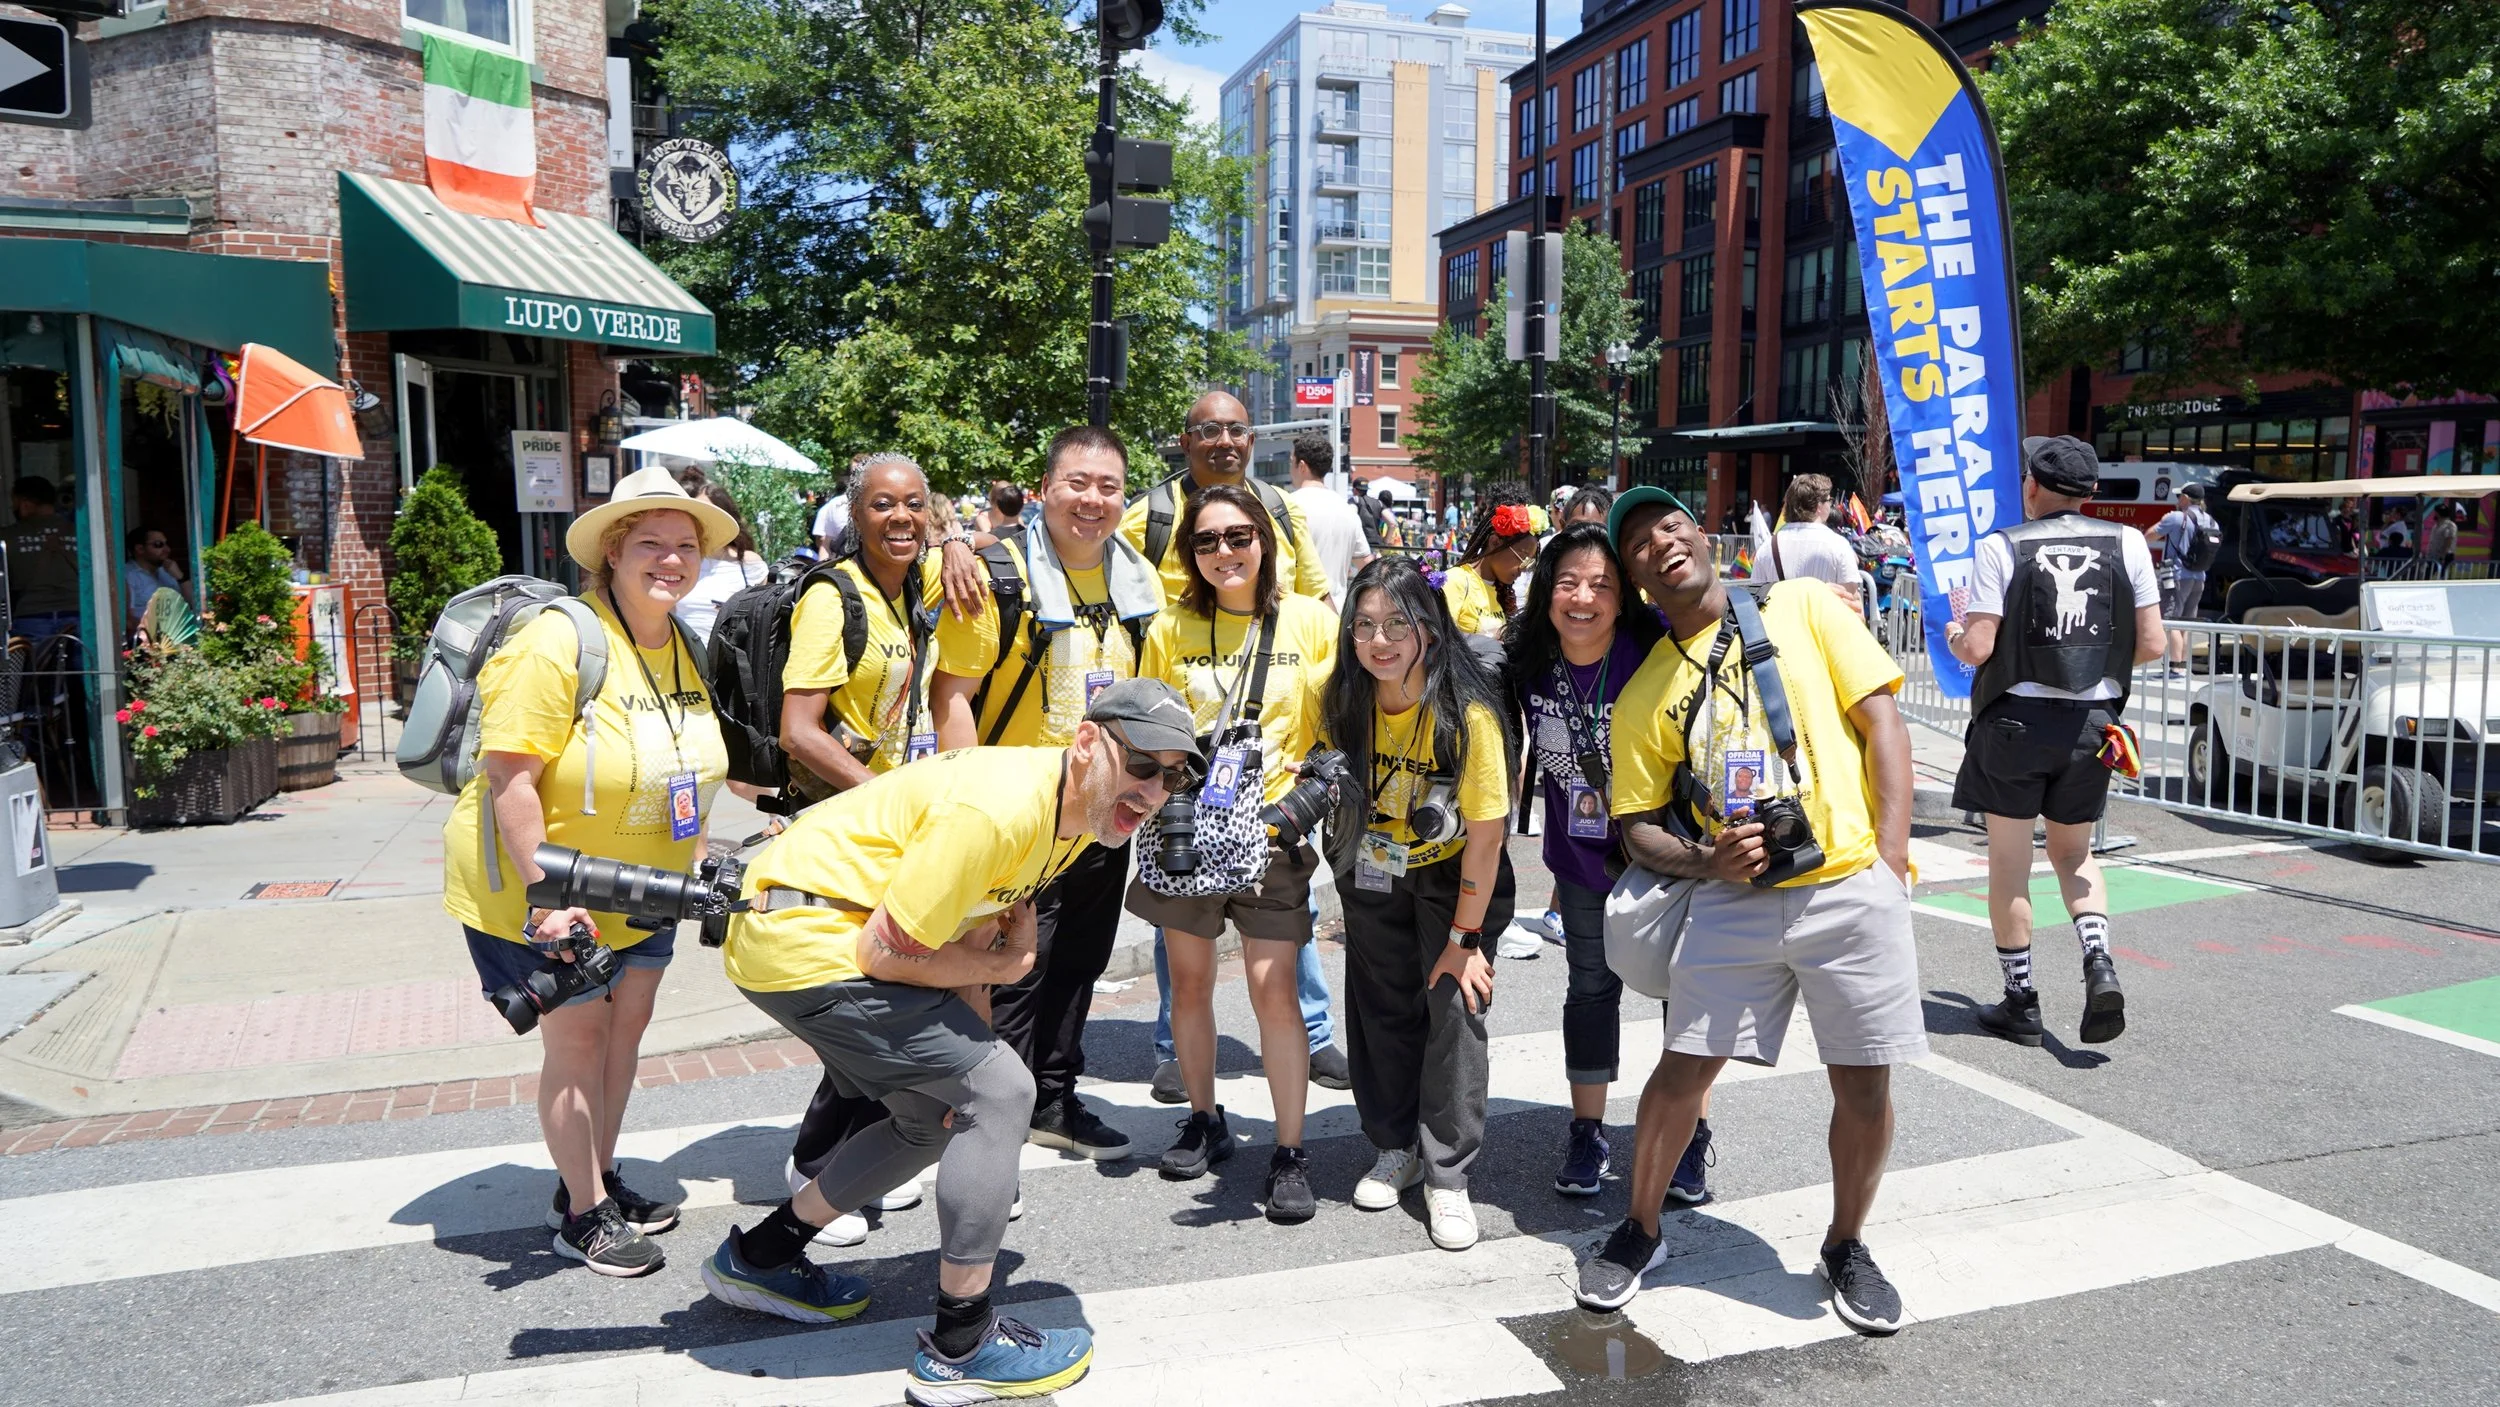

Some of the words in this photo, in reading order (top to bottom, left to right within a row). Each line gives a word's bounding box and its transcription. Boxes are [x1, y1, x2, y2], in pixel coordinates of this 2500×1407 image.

[645, 137, 683, 164] LUPO
[683, 137, 729, 169] VERDE
[1915, 153, 1976, 281] THE
[505, 296, 582, 333] LUPO
[588, 307, 681, 344] VERDE
[1866, 165, 1945, 404] STARTS
[1912, 426, 1976, 595] HERE
[1939, 304, 1996, 560] PARAD
[522, 440, 562, 453] PRIDE
[2096, 506, 2115, 517] EMS
[2119, 507, 2137, 518] UTV
[2045, 626, 2057, 638] M
[2088, 624, 2099, 636] C
[1804, 733, 1812, 748] MAY
[1727, 751, 1762, 759] OFFICIAL
[677, 817, 694, 827] LACEY
[925, 1360, 964, 1381] HOKA
